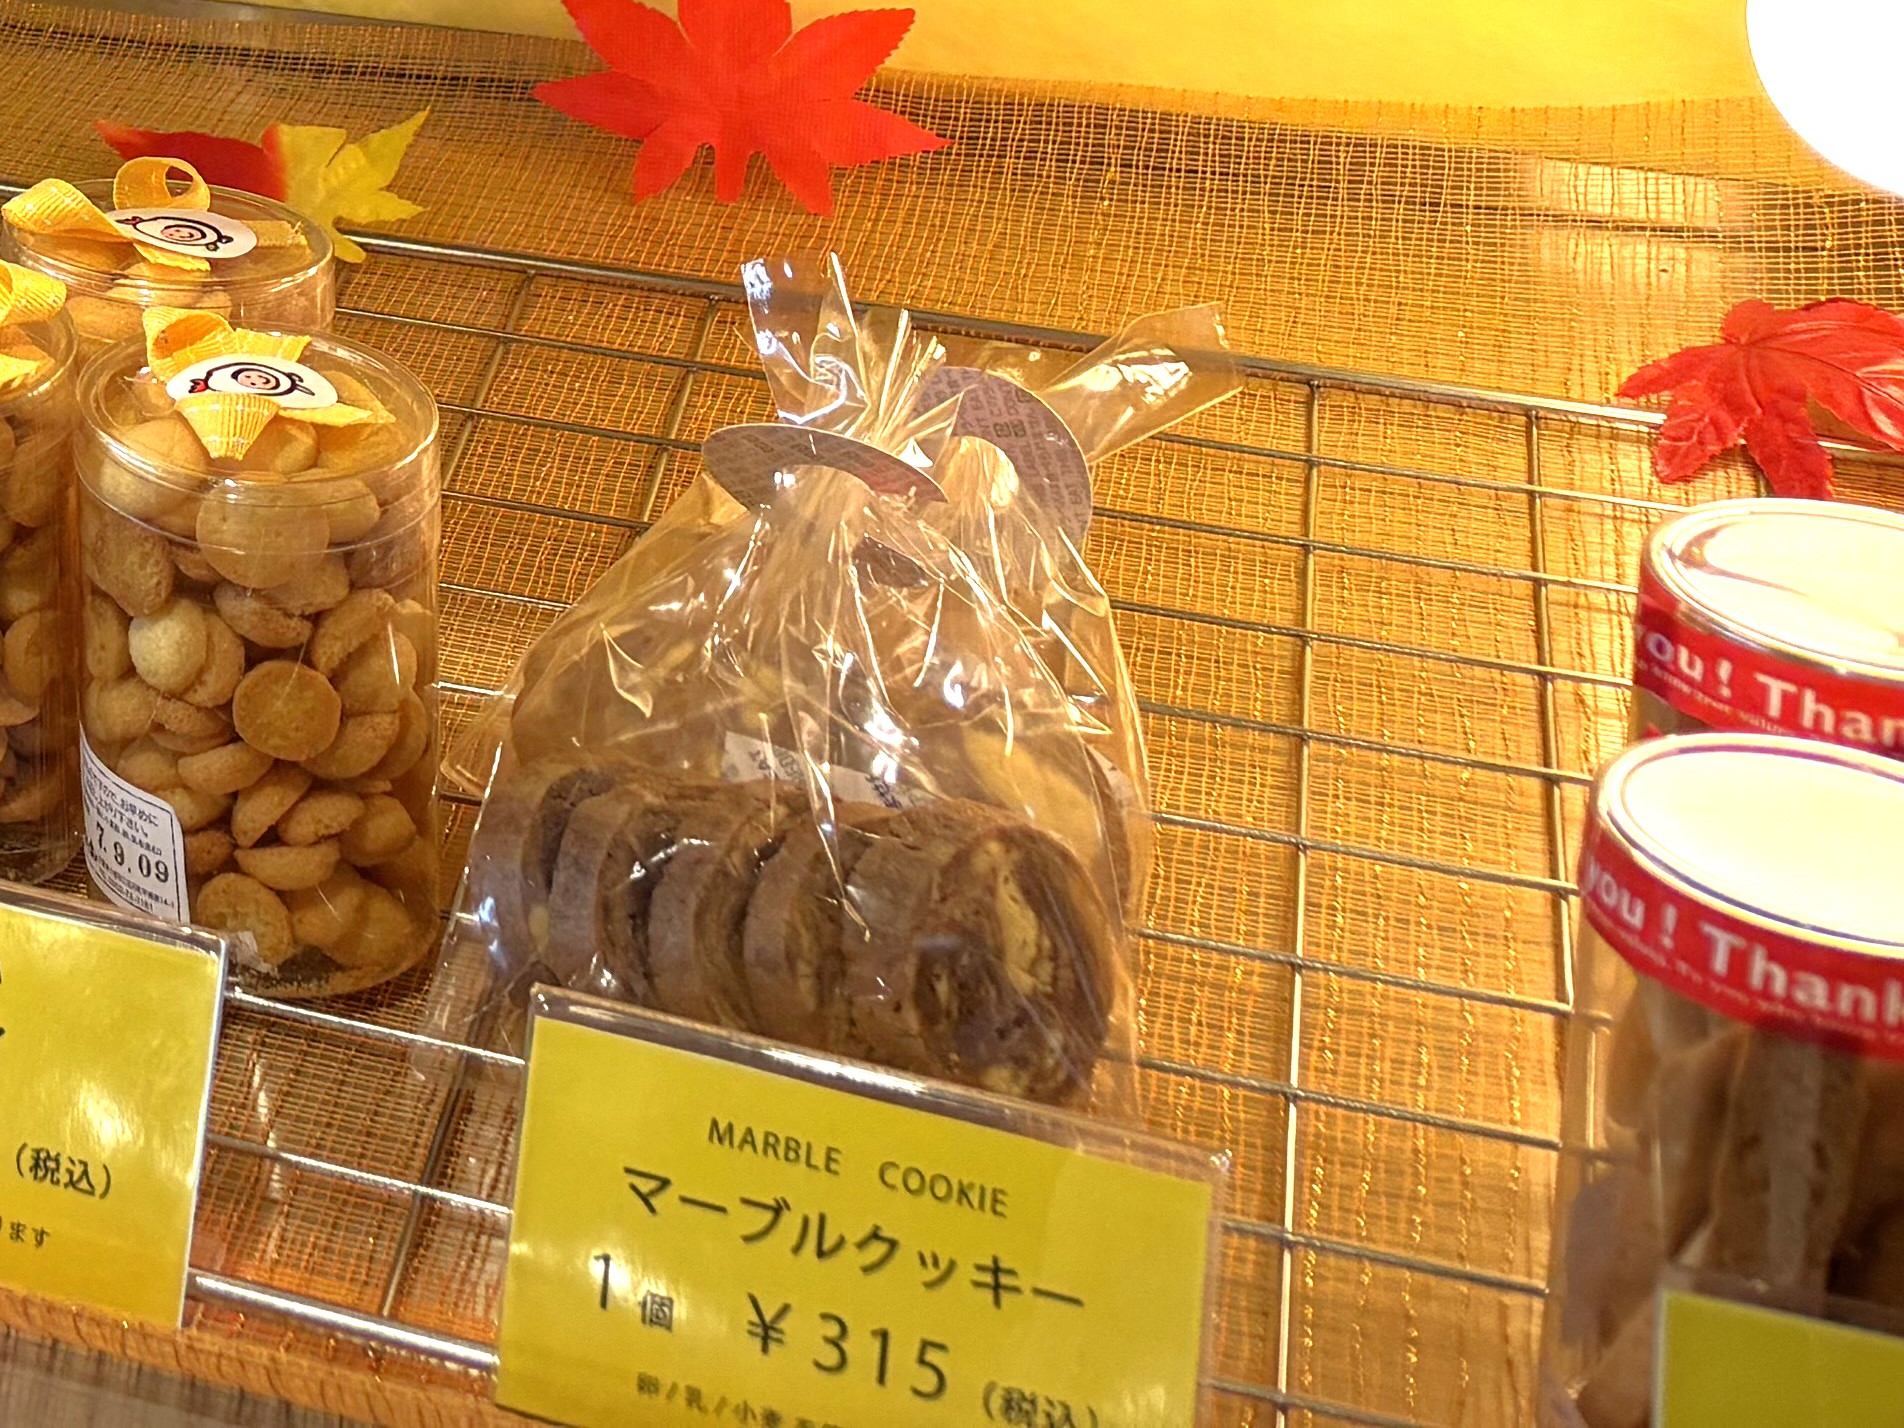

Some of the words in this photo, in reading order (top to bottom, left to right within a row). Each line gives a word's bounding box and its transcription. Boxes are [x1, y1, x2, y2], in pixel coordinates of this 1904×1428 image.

[707, 1116, 843, 1178] MARBLE
[878, 1160, 1010, 1220] COOKIE
[622, 1165, 1085, 1311] マーブルクッキー
